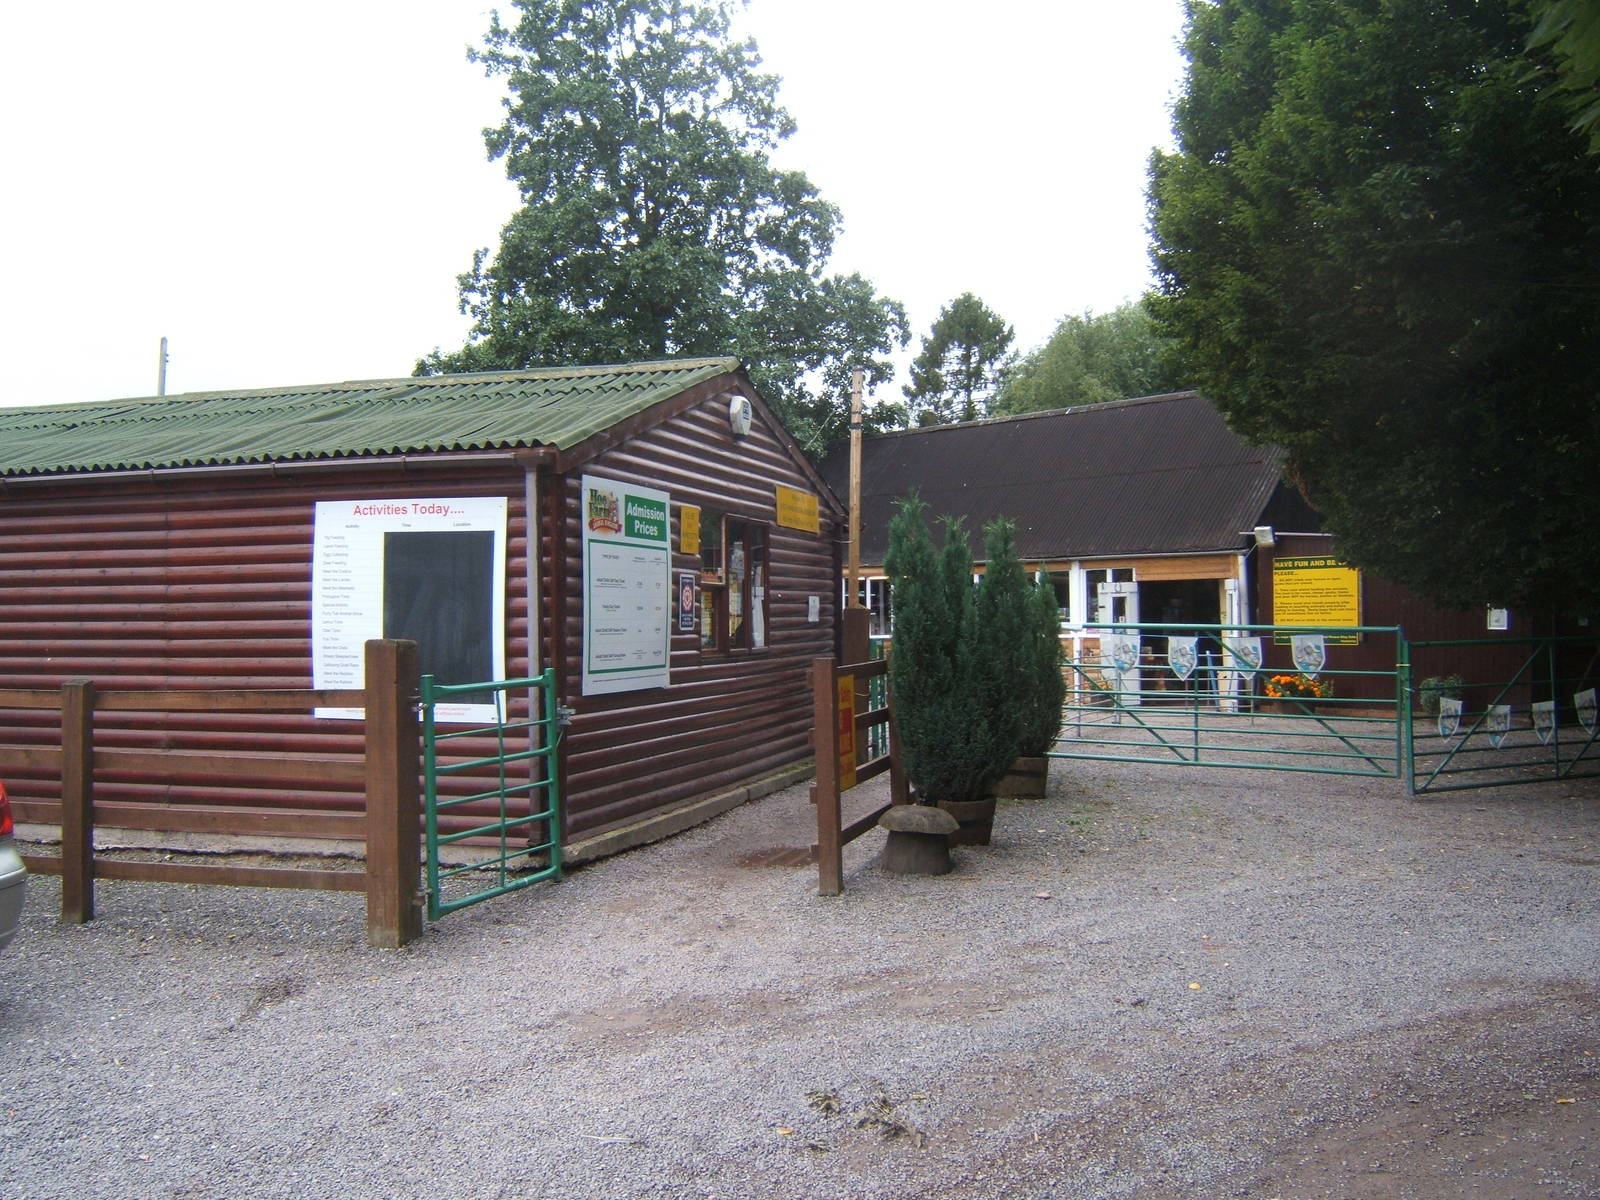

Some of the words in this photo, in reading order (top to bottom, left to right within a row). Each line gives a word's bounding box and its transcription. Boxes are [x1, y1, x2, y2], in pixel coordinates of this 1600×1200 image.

[353, 504, 408, 516] Activities
[626, 502, 665, 521] Admission
[634, 520, 659, 536] Prices
